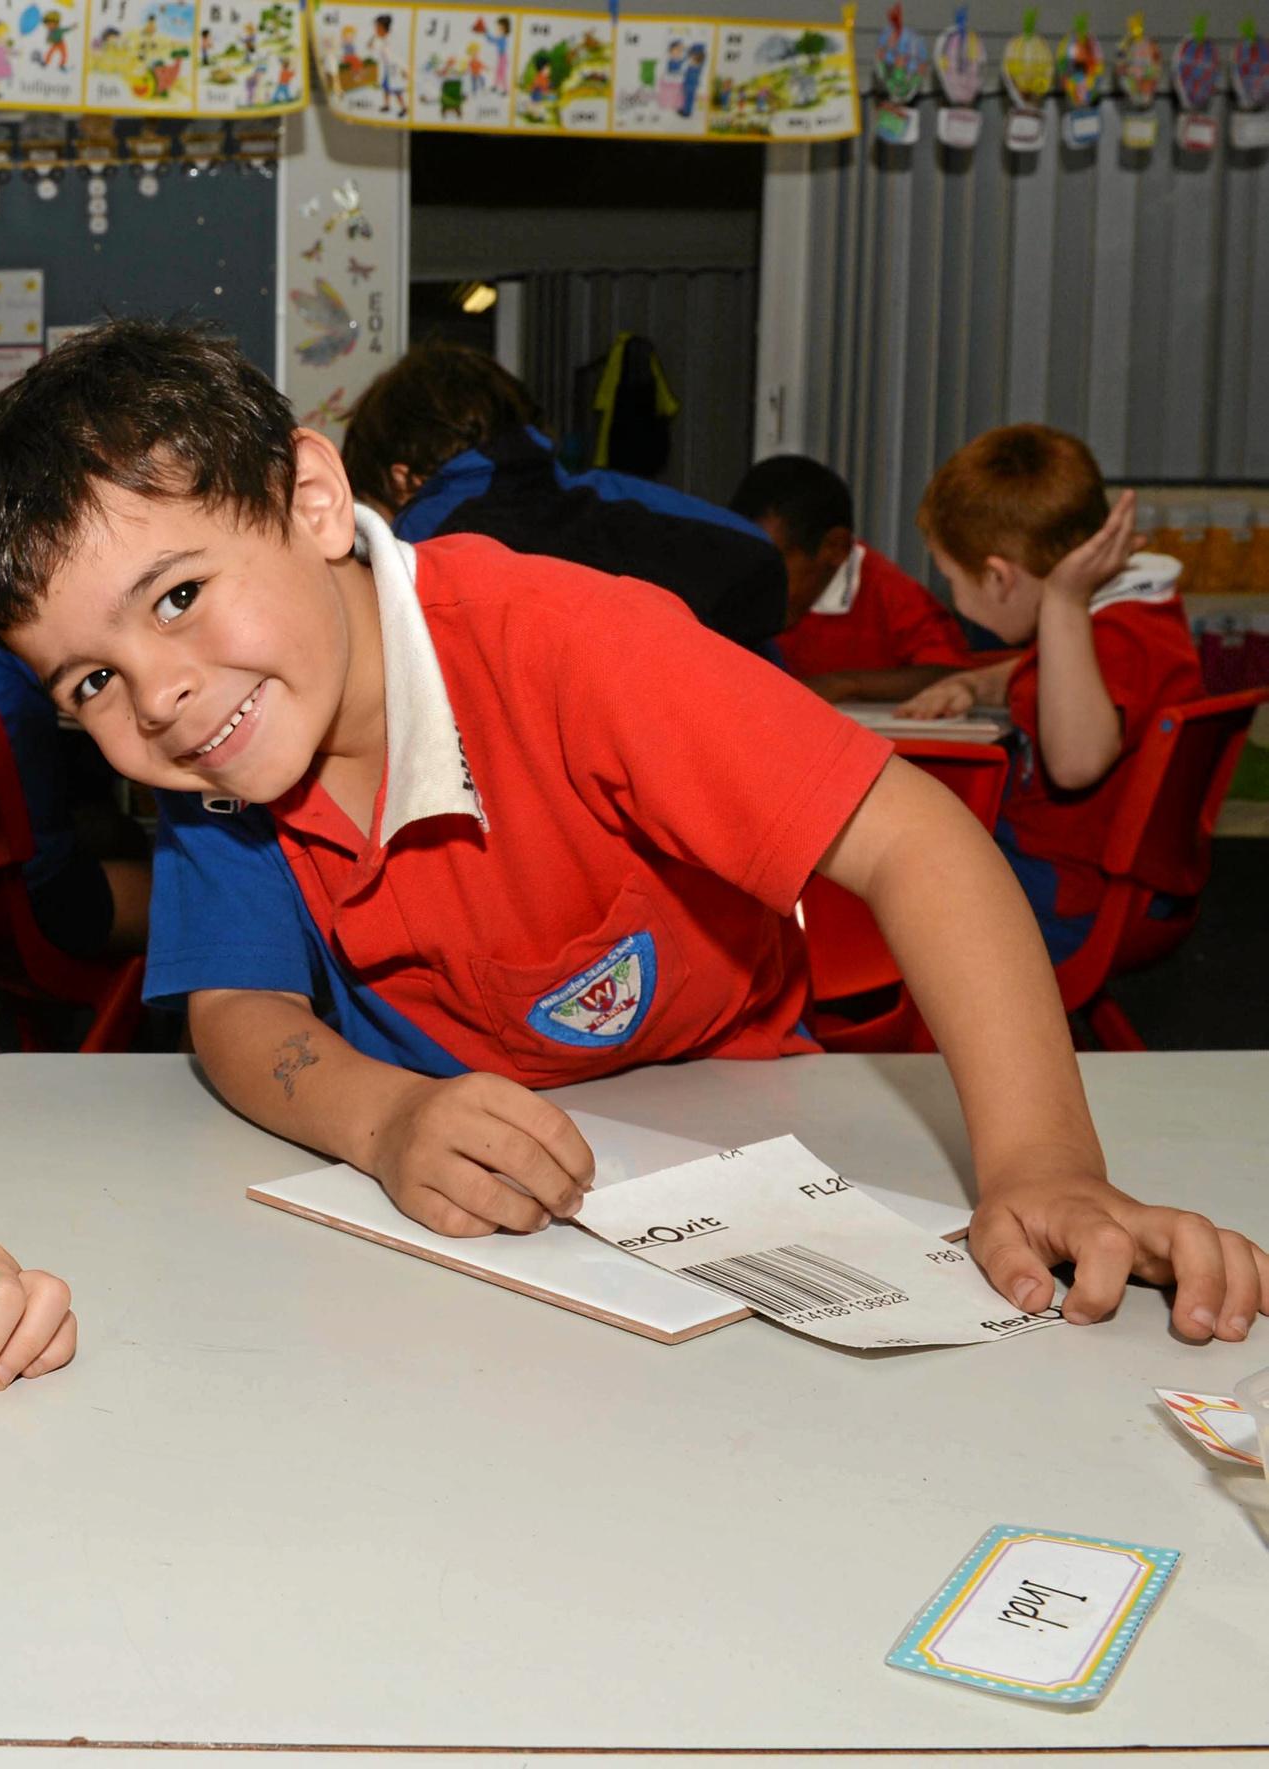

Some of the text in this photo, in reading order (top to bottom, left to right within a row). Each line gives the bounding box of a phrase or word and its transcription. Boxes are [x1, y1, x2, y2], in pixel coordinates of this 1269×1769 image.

[425, 17, 438, 37] J
[617, 1216, 722, 1248] exOvit
[925, 1248, 965, 1265] P80
[997, 1578, 1088, 1632] Indi
